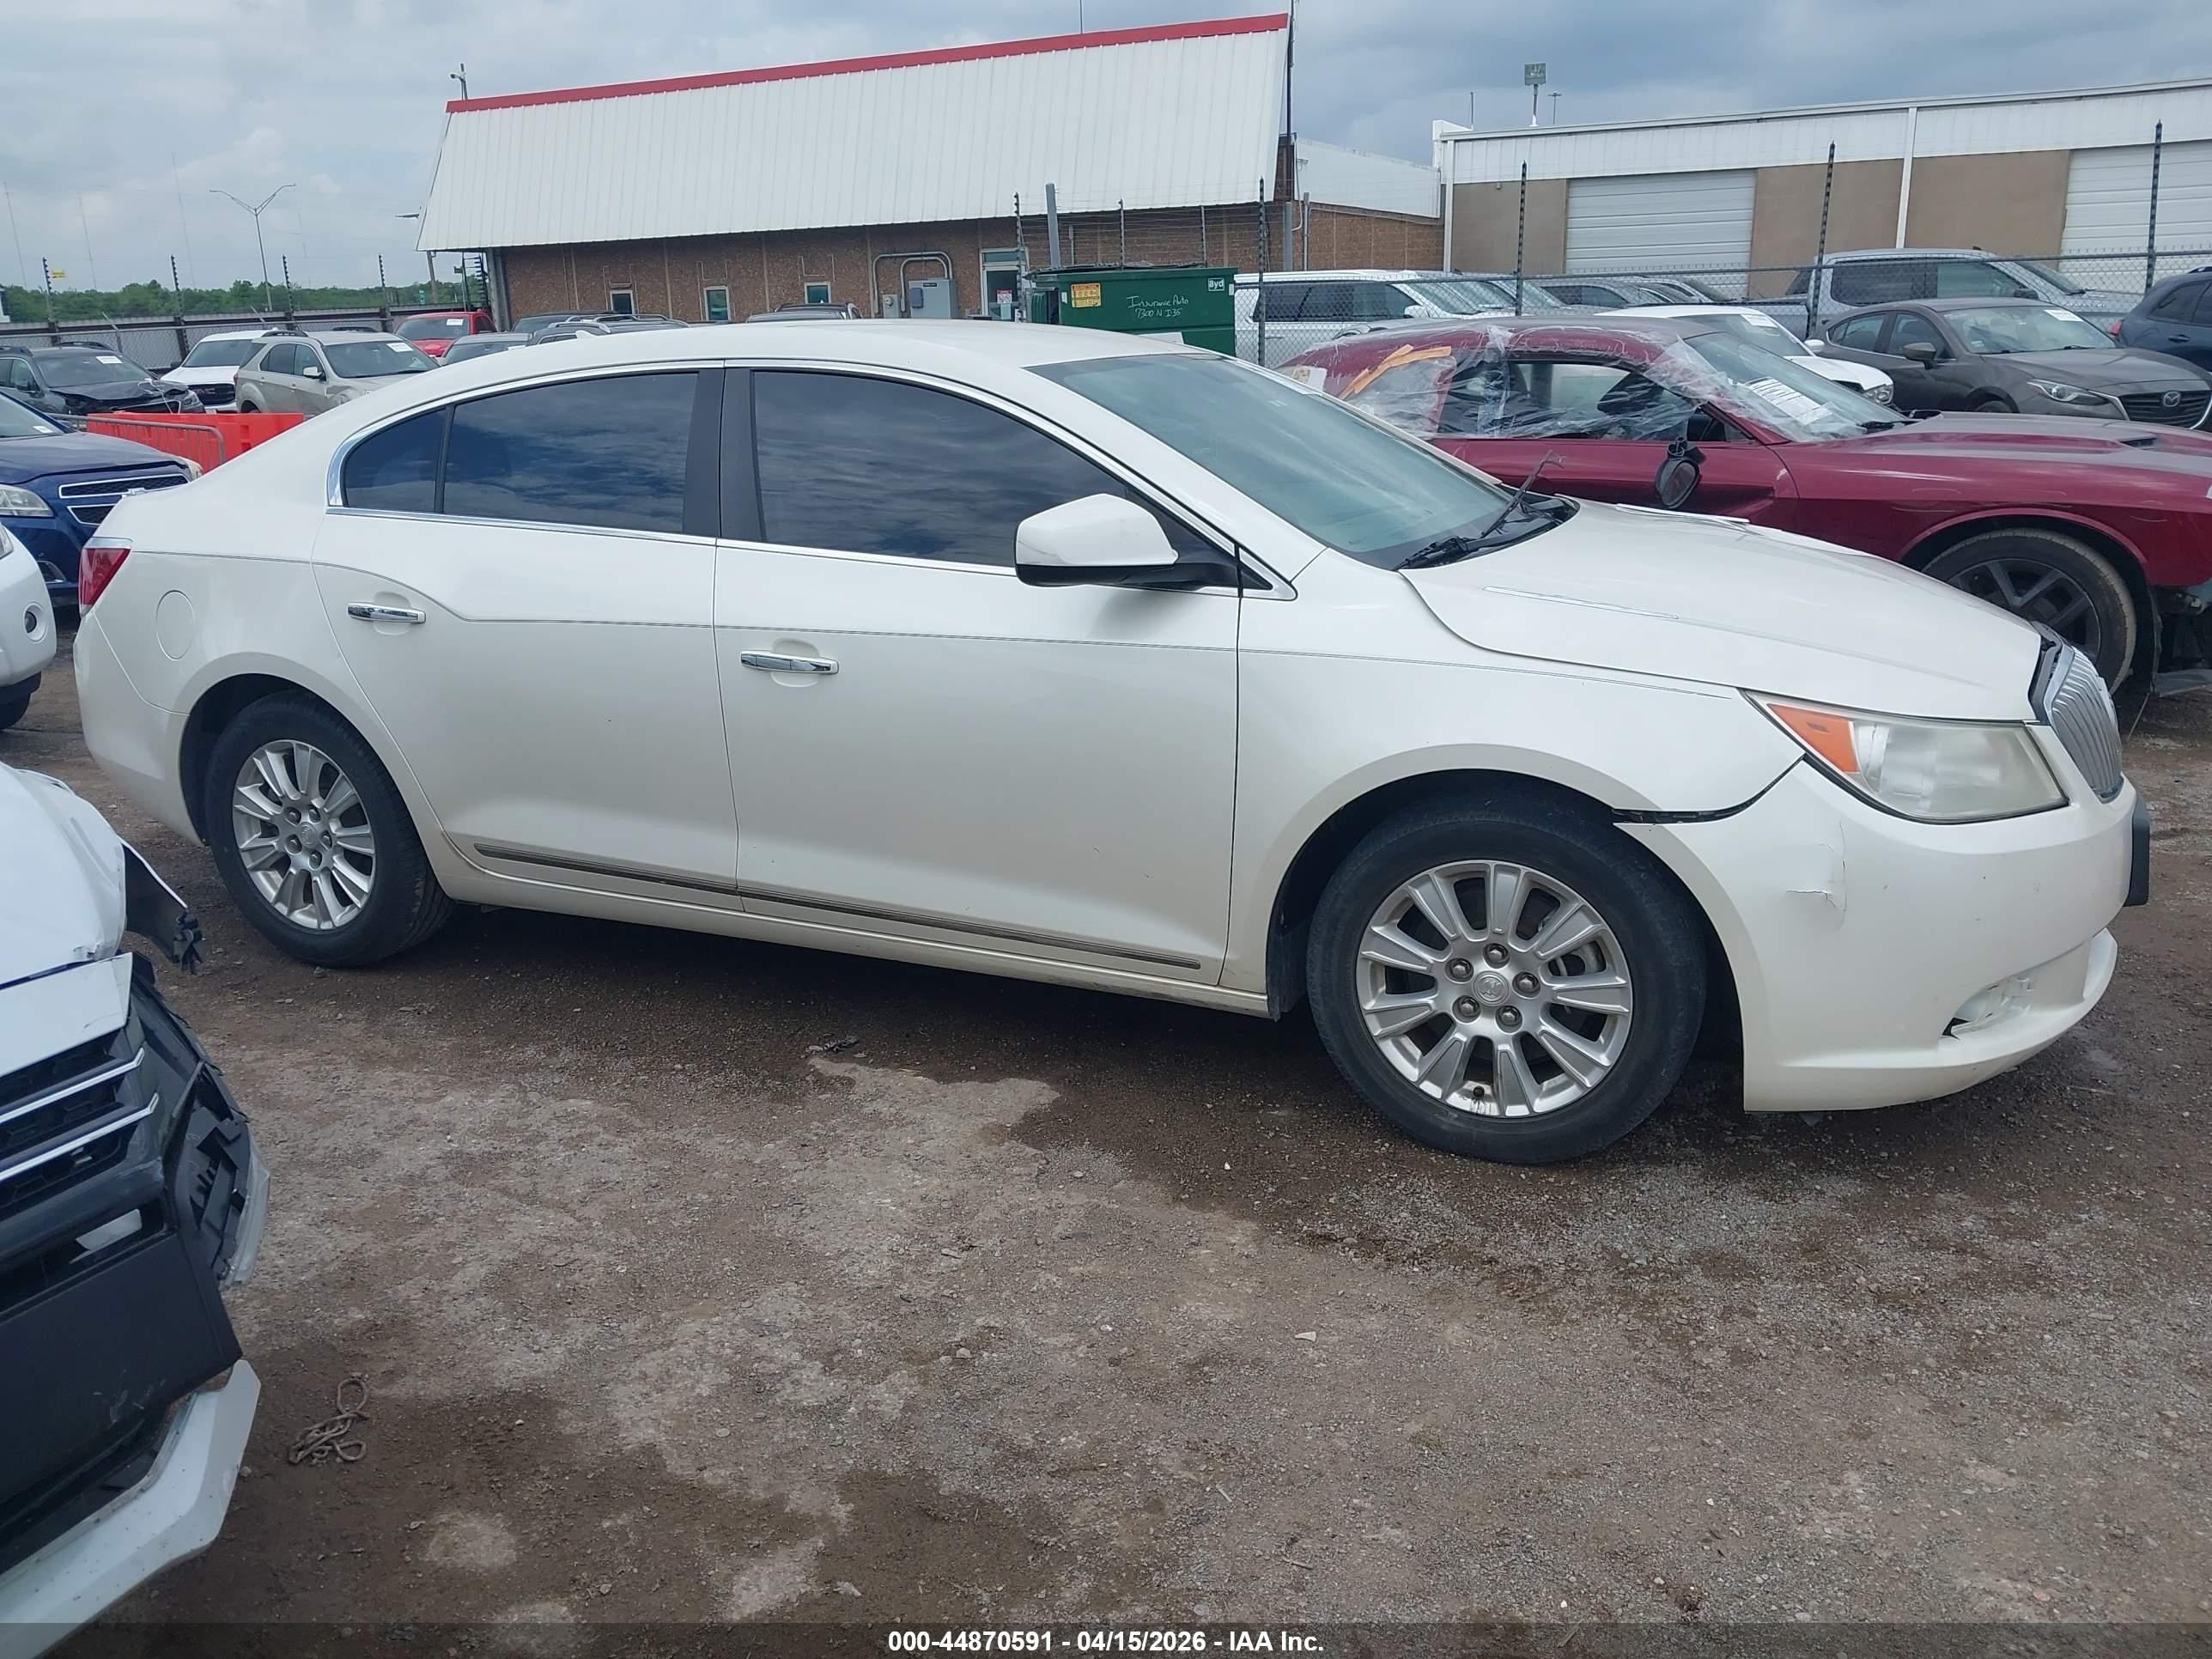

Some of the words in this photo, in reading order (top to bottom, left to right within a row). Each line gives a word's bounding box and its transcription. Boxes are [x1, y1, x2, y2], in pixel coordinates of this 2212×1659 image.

[1127, 295, 1171, 308] Insurance
[1172, 294, 1189, 306] Auto
[1156, 308, 1163, 317] N
